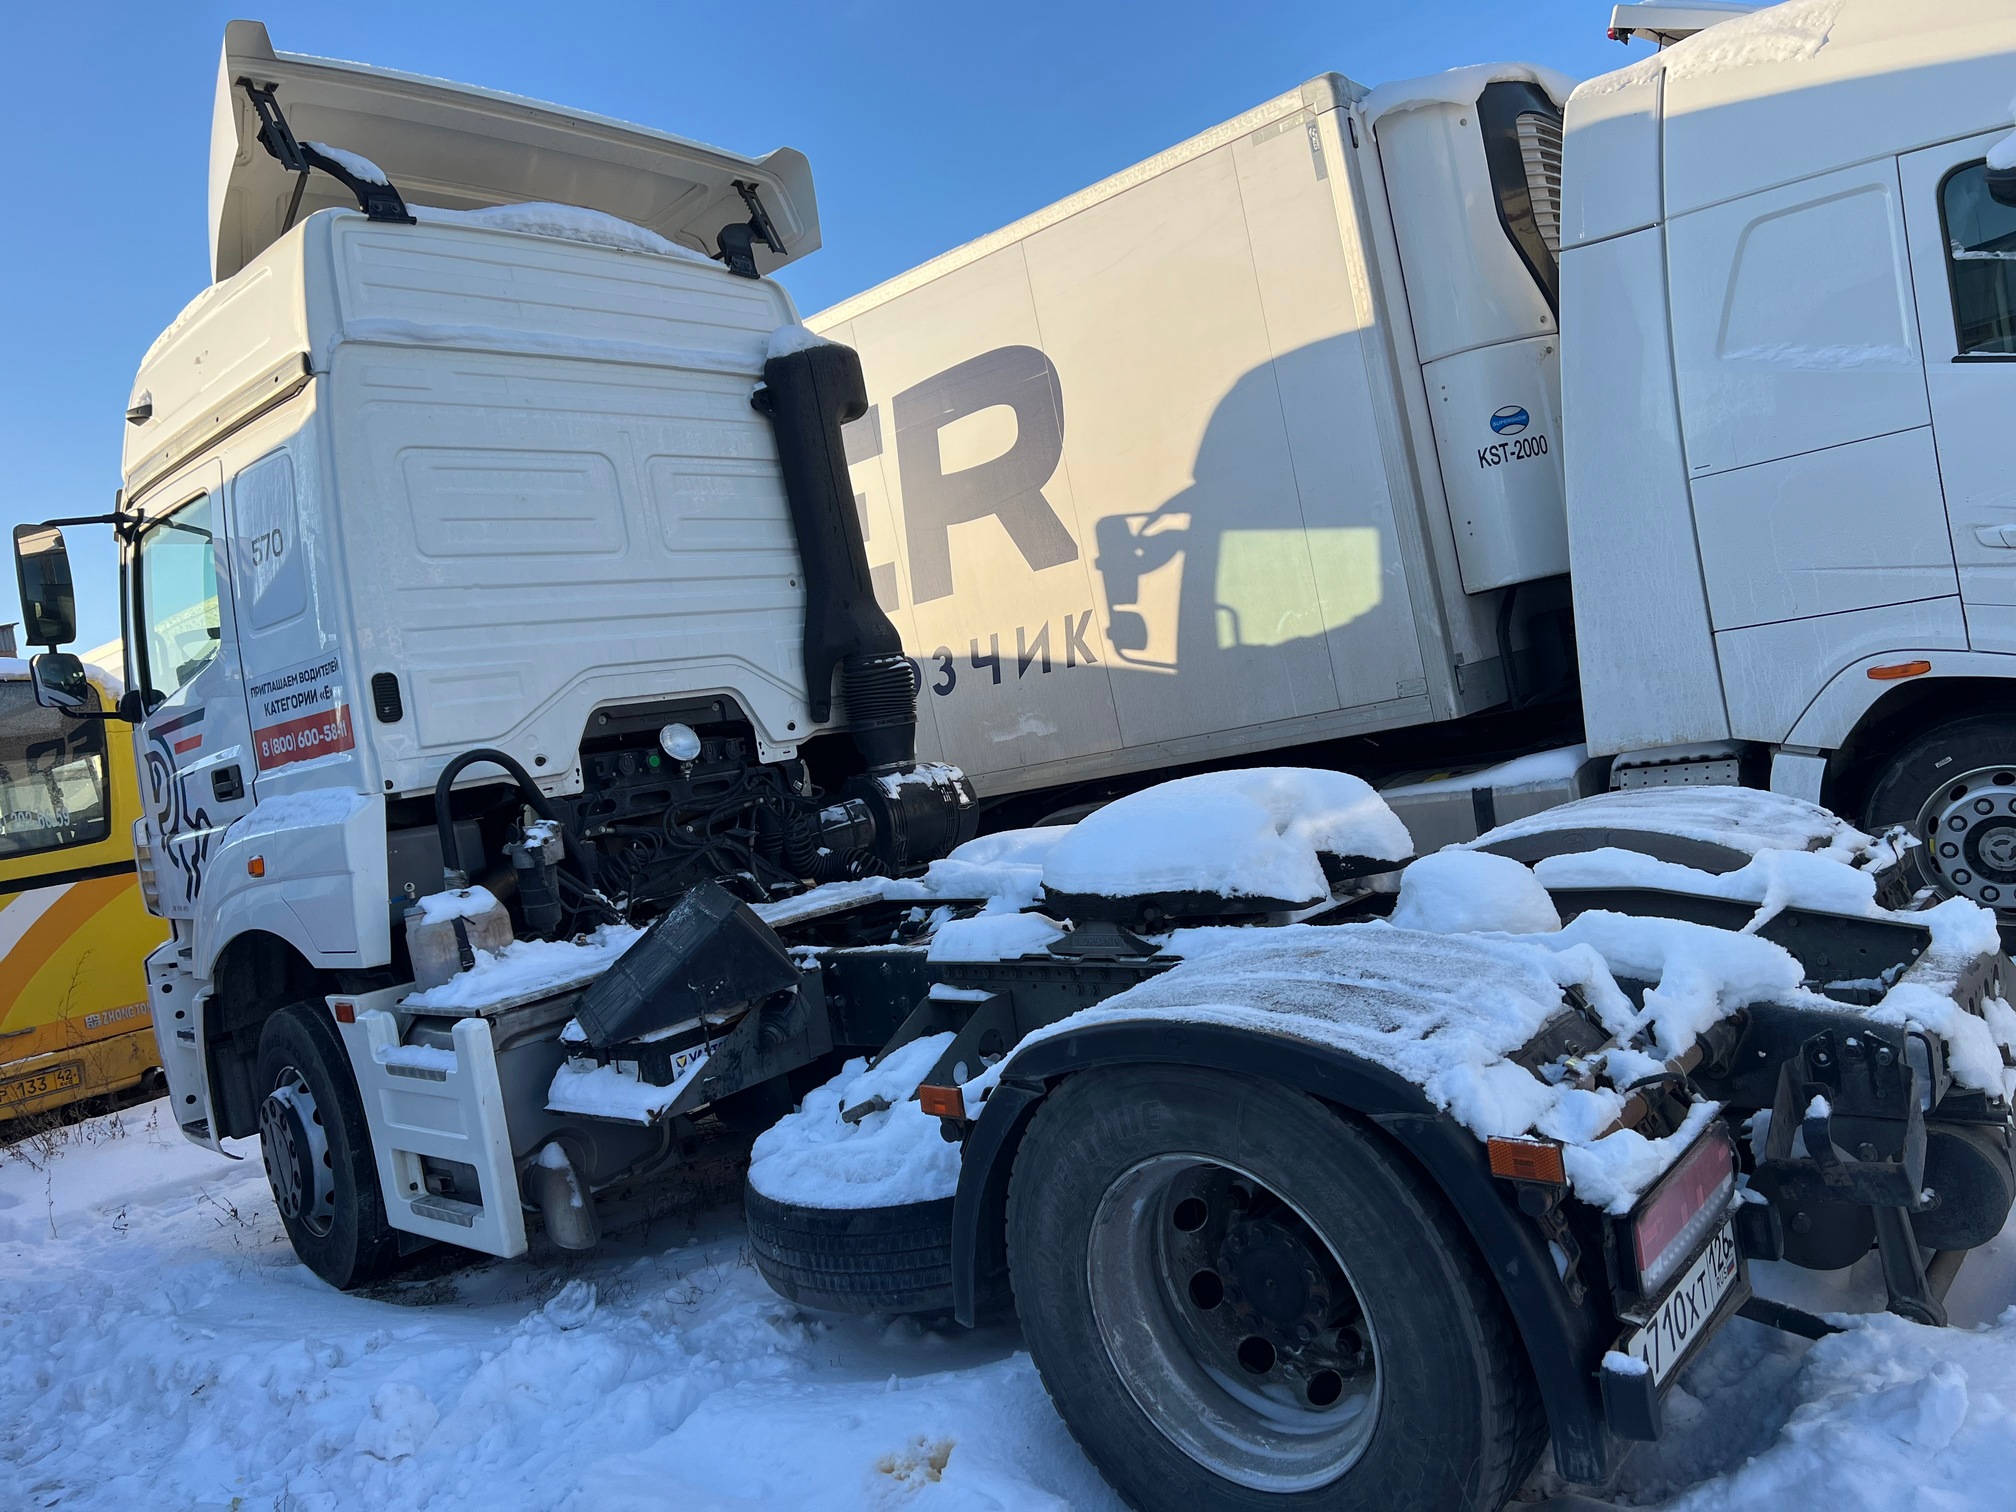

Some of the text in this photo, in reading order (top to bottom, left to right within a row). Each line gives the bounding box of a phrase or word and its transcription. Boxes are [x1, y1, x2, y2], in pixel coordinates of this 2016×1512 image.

[1477, 434, 1548, 469] KST-2000
[251, 528, 283, 567] 570
[250, 656, 340, 699] ПРИГЛАШАЕМ ВОДИТЕЛЕЙ
[263, 688, 319, 717] КАТЕГОРИИ
[261, 740, 270, 758] 8
[270, 732, 297, 757] (800)
[102, 1005, 135, 1026] ZHONG
[17, 1076, 47, 1097] 133
[57, 1069, 73, 1082] 42
[1709, 1227, 1730, 1278] 126
[1716, 1270, 1728, 1291] RUS
